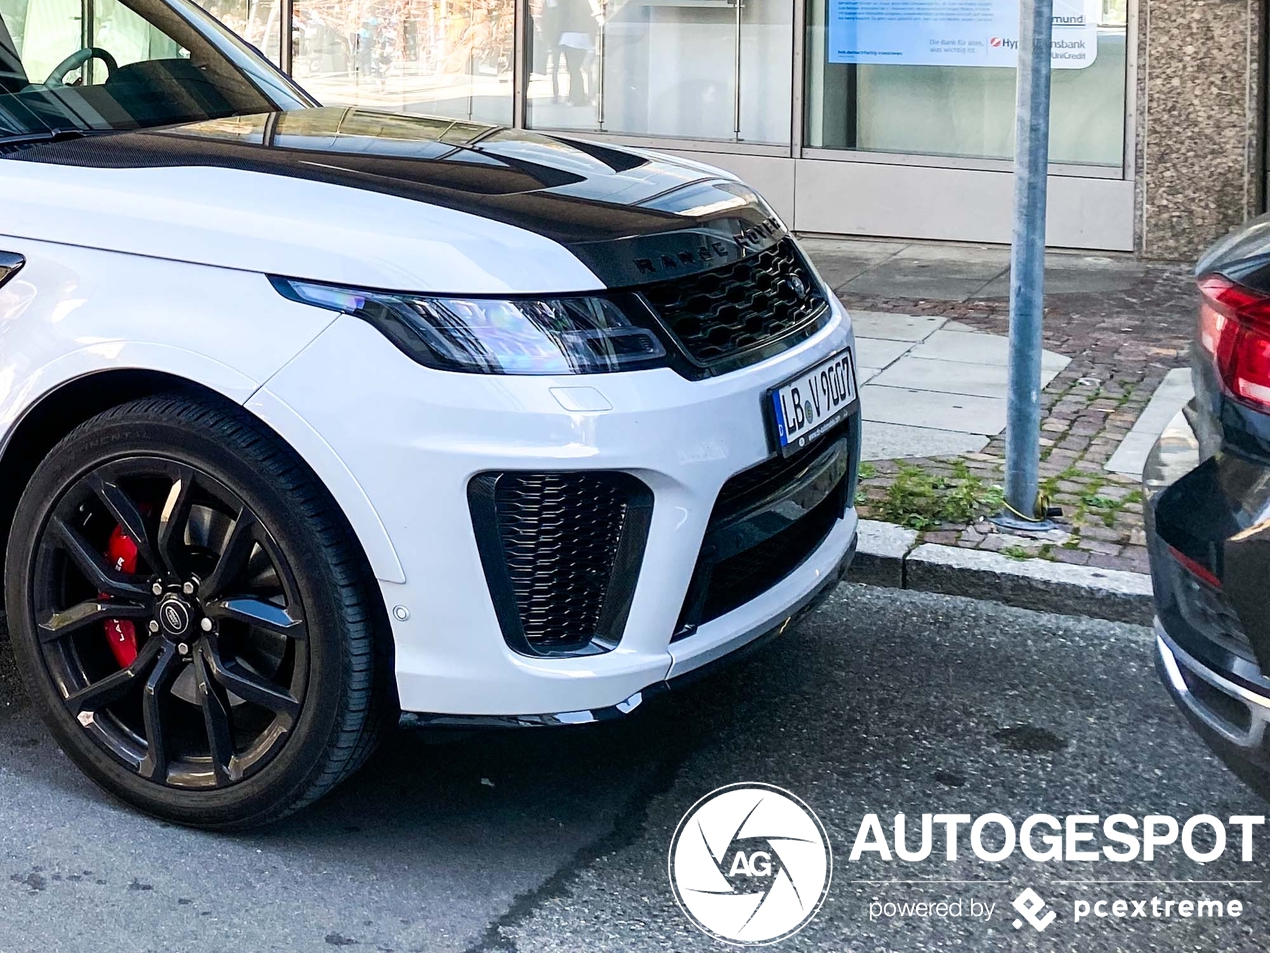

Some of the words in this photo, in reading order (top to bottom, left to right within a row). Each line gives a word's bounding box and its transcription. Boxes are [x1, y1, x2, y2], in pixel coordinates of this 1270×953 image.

[1051, 52, 1086, 60] UniCredit
[633, 241, 728, 274] RANGE
[782, 387, 805, 436] LB
[808, 375, 821, 418] V
[820, 356, 851, 411] 9007
